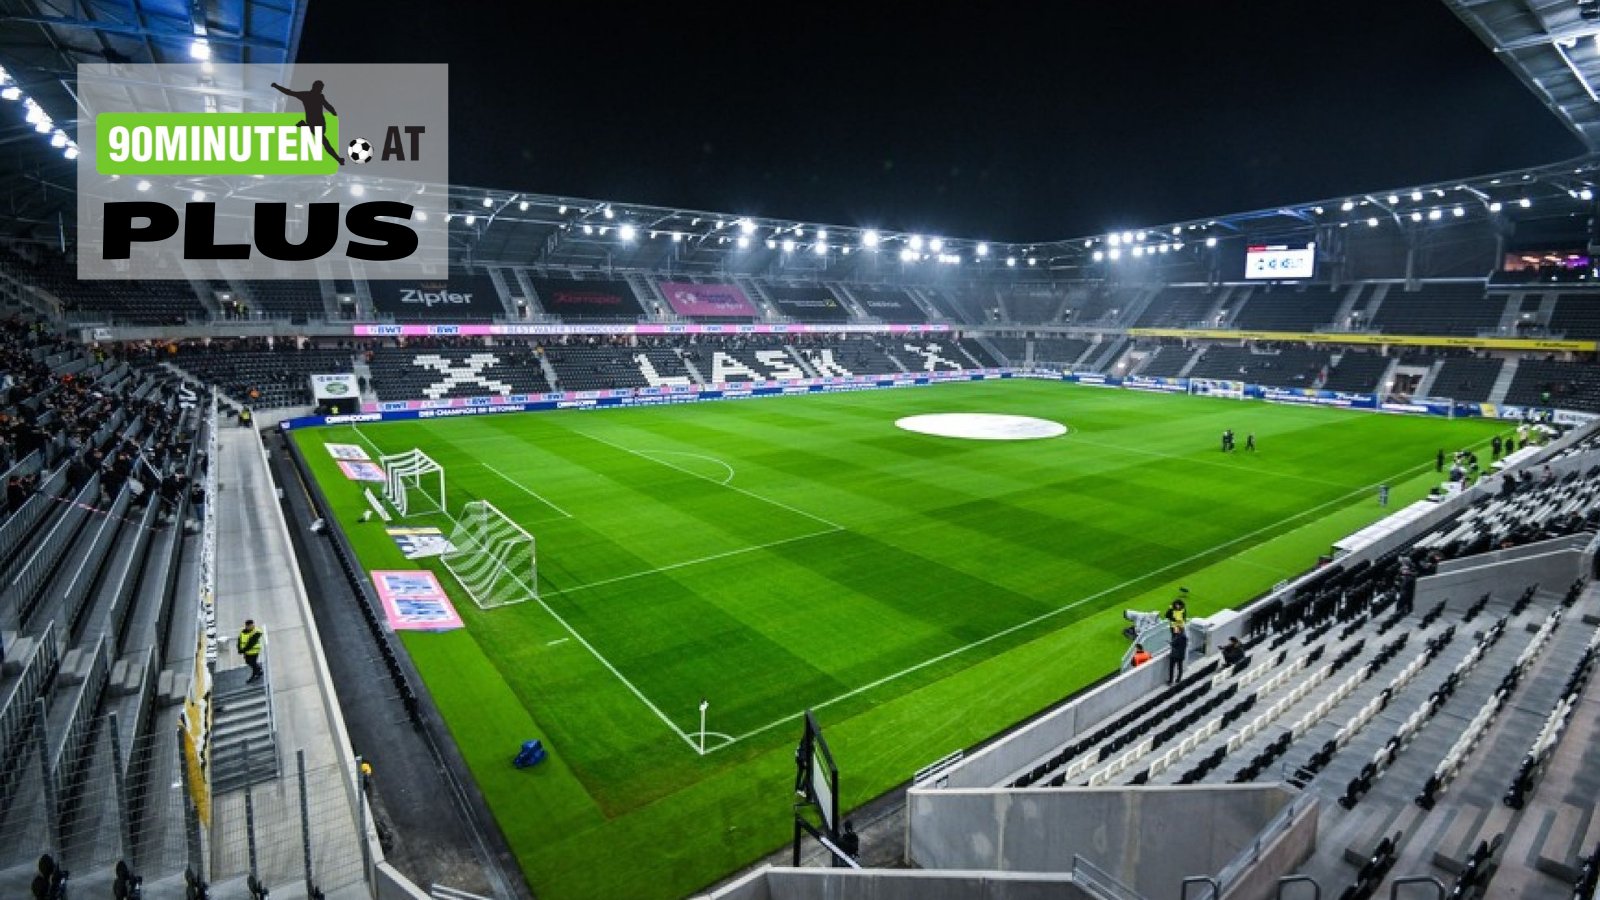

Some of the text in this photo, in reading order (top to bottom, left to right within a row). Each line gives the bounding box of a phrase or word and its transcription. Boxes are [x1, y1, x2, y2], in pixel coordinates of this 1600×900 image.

[400, 289, 472, 306] Zipfer
[378, 325, 402, 334] BWT
[437, 325, 459, 334] BWT
[633, 349, 852, 387] LASK
